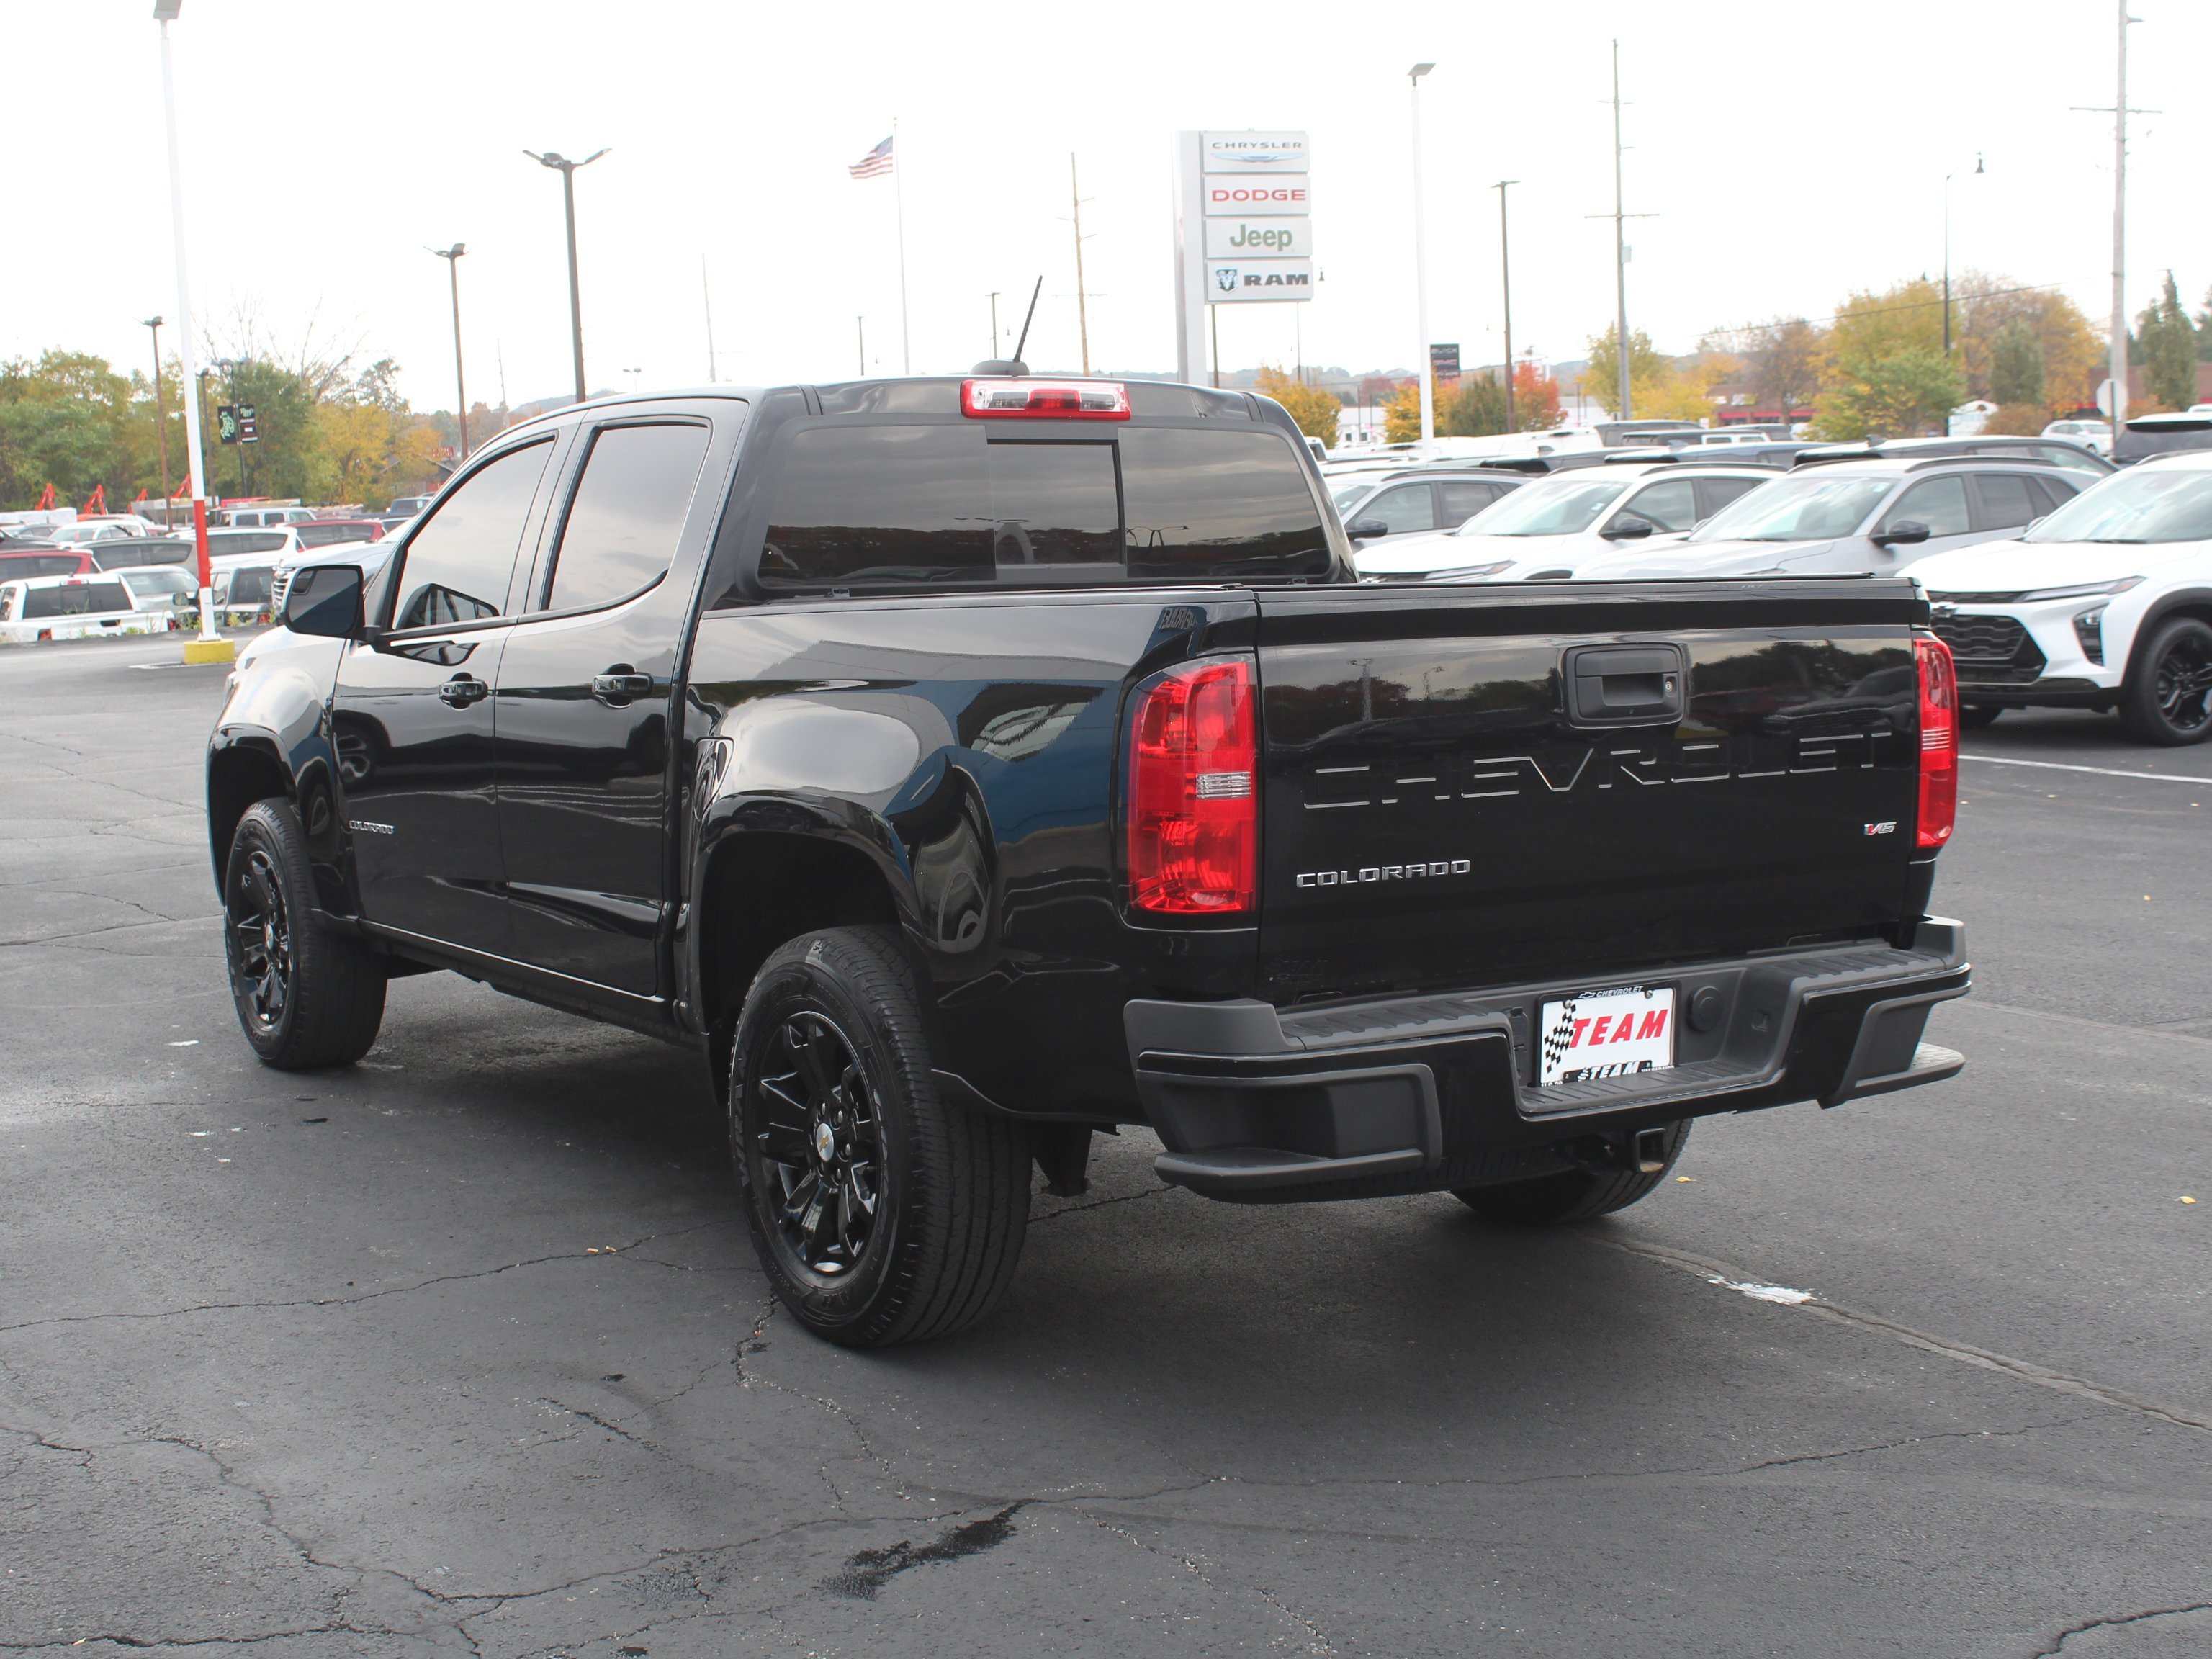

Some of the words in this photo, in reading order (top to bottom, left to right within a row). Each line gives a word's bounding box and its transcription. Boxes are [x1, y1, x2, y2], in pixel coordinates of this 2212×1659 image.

[1211, 189, 1306, 202] DODGE
[1229, 224, 1293, 251] Jeep
[1244, 274, 1309, 286] RAM
[1304, 732, 1892, 809] CHEVROLET
[349, 820, 395, 835] COLORADO
[1863, 821, 1897, 835] V6
[1296, 860, 1470, 888] COLORADO
[1596, 986, 1644, 998] CHEVROLET
[1569, 1009, 1669, 1048] TEAM
[1588, 1061, 1640, 1080] TEAM
